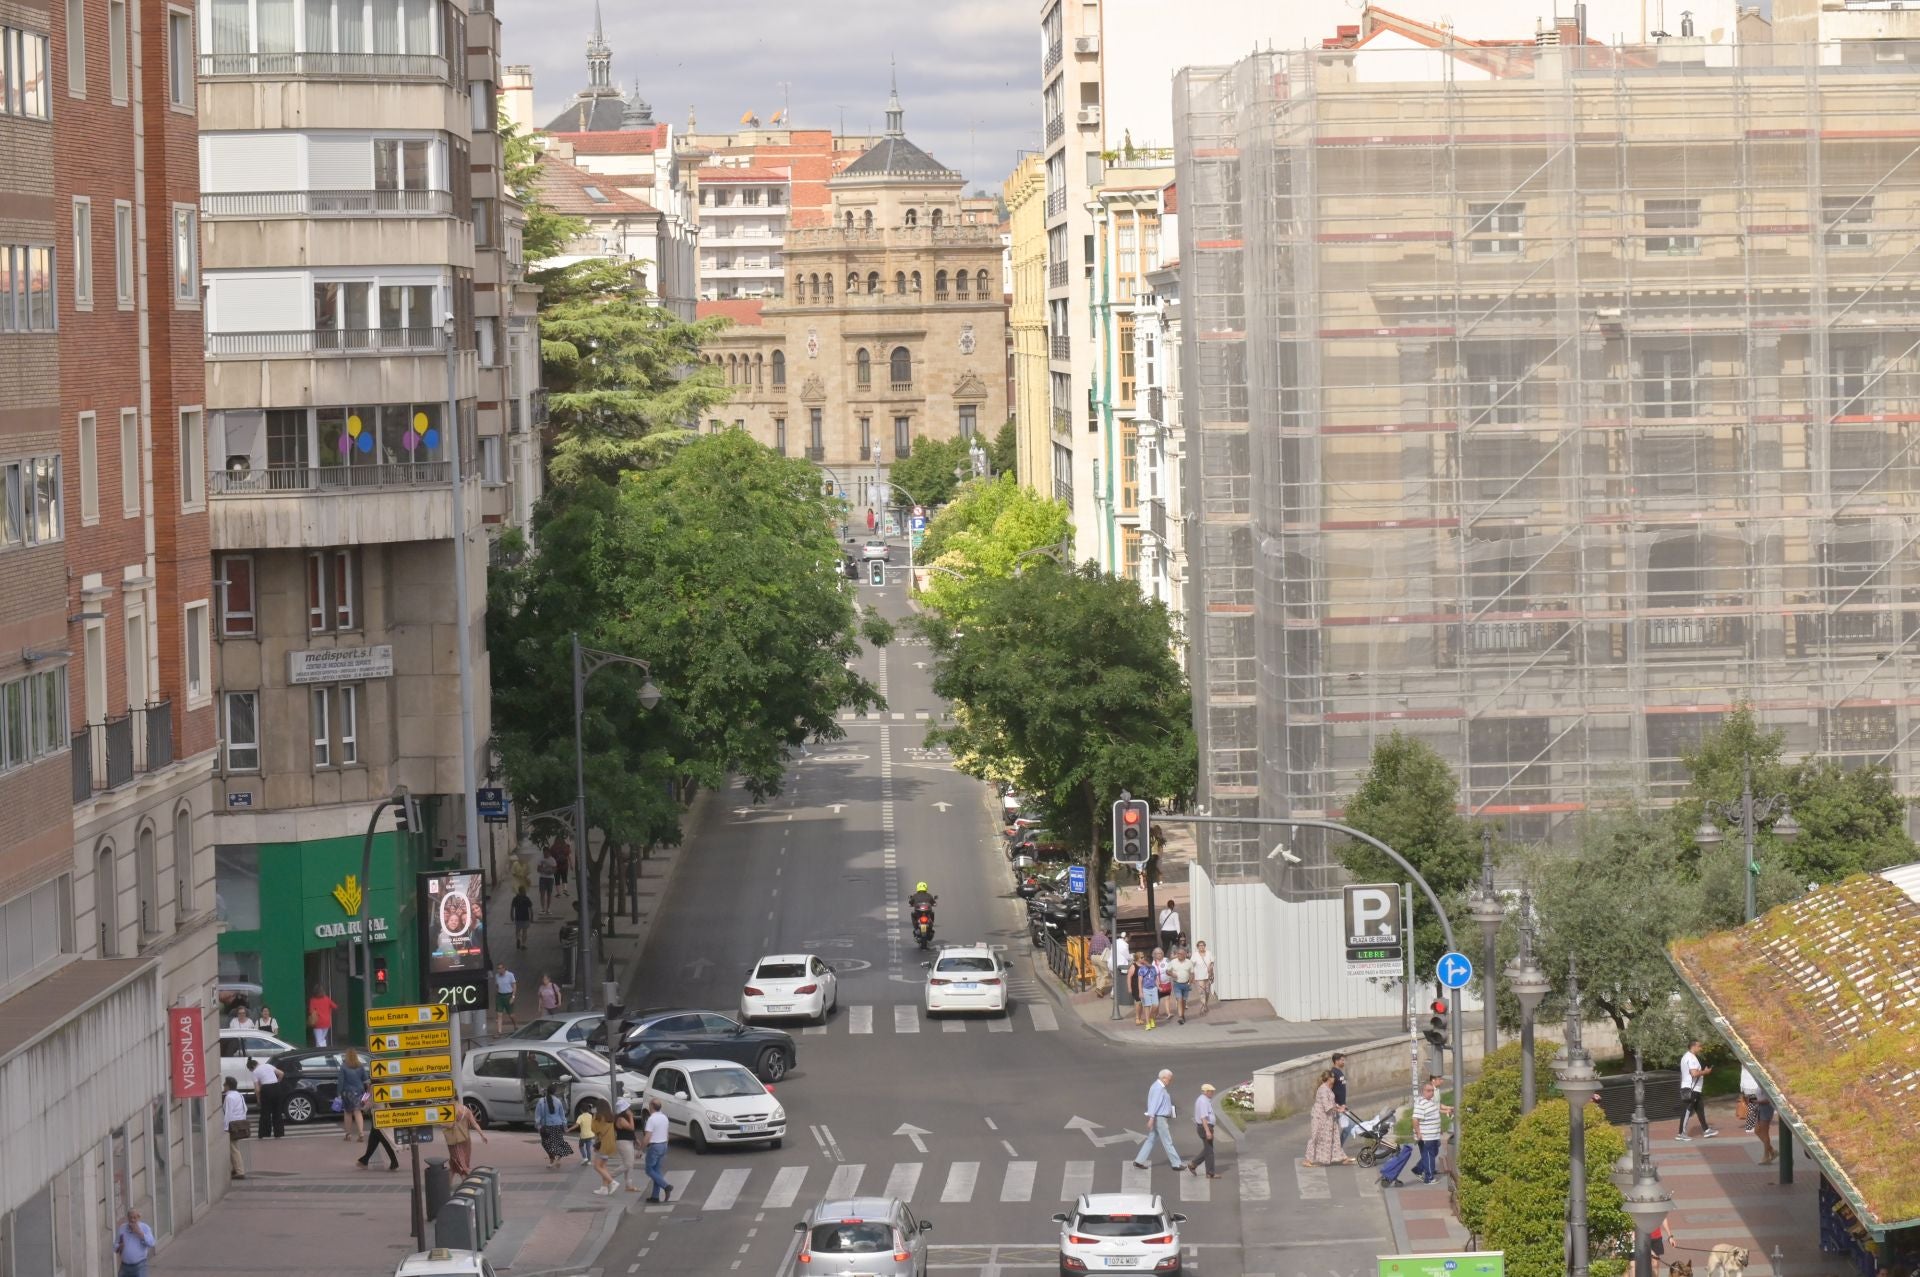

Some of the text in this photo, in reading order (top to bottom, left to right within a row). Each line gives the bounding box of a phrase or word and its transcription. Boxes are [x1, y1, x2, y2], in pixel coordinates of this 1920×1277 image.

[1352, 889, 1391, 937] P
[315, 922, 347, 937] CAJA
[1358, 951, 1385, 959] LIBRE
[438, 985, 476, 1005] 21°C
[421, 1032, 439, 1040] Felipe
[181, 1015, 196, 1090] VISIONLAB
[426, 1064, 449, 1072] Parque
[424, 1085, 451, 1093] Gareus
